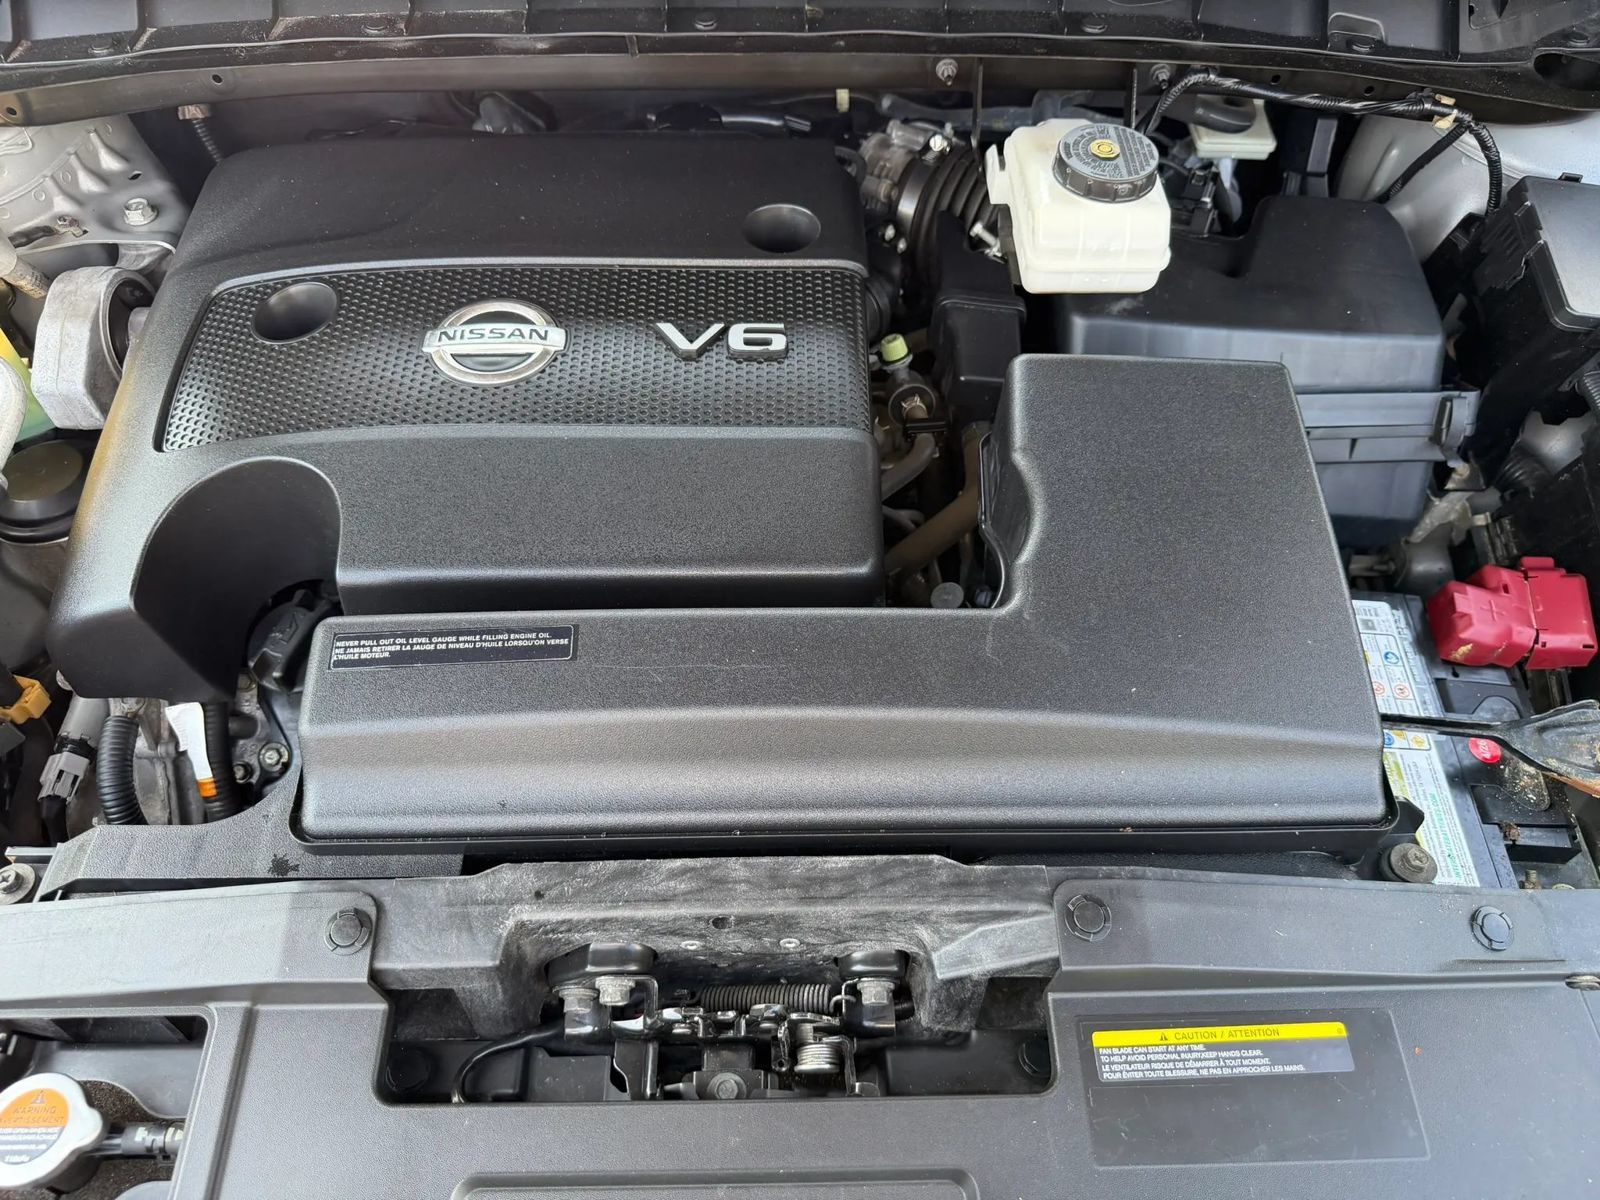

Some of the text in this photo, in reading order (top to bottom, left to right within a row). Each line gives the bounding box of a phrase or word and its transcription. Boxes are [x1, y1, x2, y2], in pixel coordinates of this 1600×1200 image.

[437, 327, 550, 343] NISSAN
[655, 322, 788, 360] V6
[475, 640, 503, 648] D'HUILE
[504, 639, 545, 647] LORSQU'ON
[1174, 1031, 1217, 1041] CAUTION
[1228, 1028, 1280, 1038] ATTENTION
[1111, 1063, 1150, 1071] VENTILATEUR
[1185, 1059, 1219, 1068] DÉMARRER
[1220, 1058, 1225, 1066] À
[1122, 1070, 1144, 1079] ÉVITER
[1165, 1069, 1199, 1077] BLESSURE,
